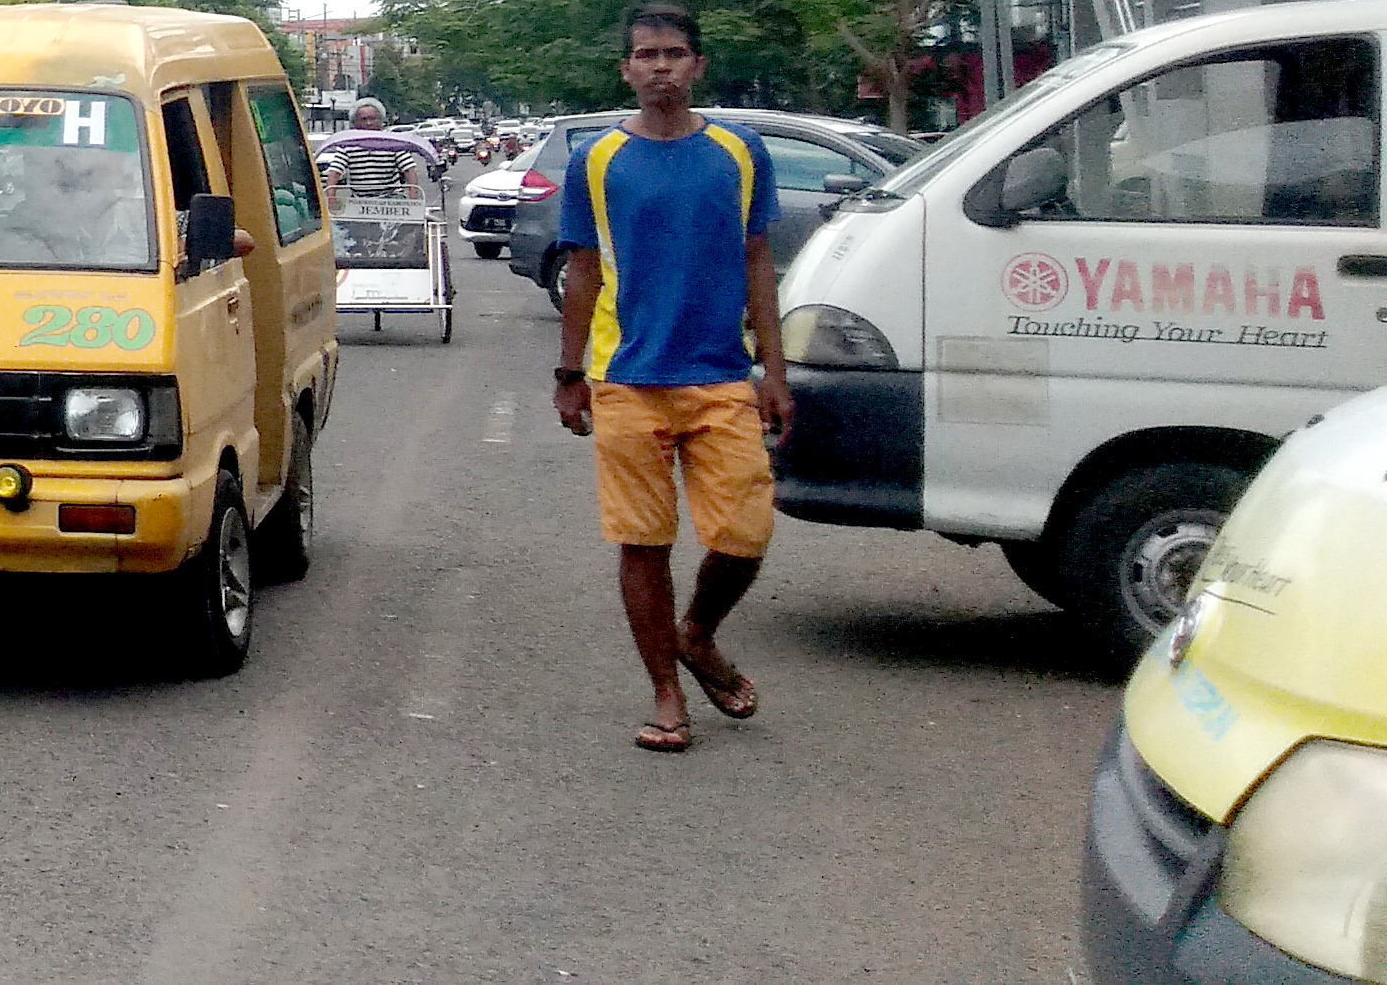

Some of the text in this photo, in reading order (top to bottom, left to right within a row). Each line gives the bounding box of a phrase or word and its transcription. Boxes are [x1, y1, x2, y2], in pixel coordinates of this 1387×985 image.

[62, 100, 106, 145] H
[358, 206, 411, 216] JEMBER
[1074, 257, 1325, 321] YAMAHA
[18, 304, 156, 351] 280
[1007, 315, 1329, 347] Touching Your Heart
